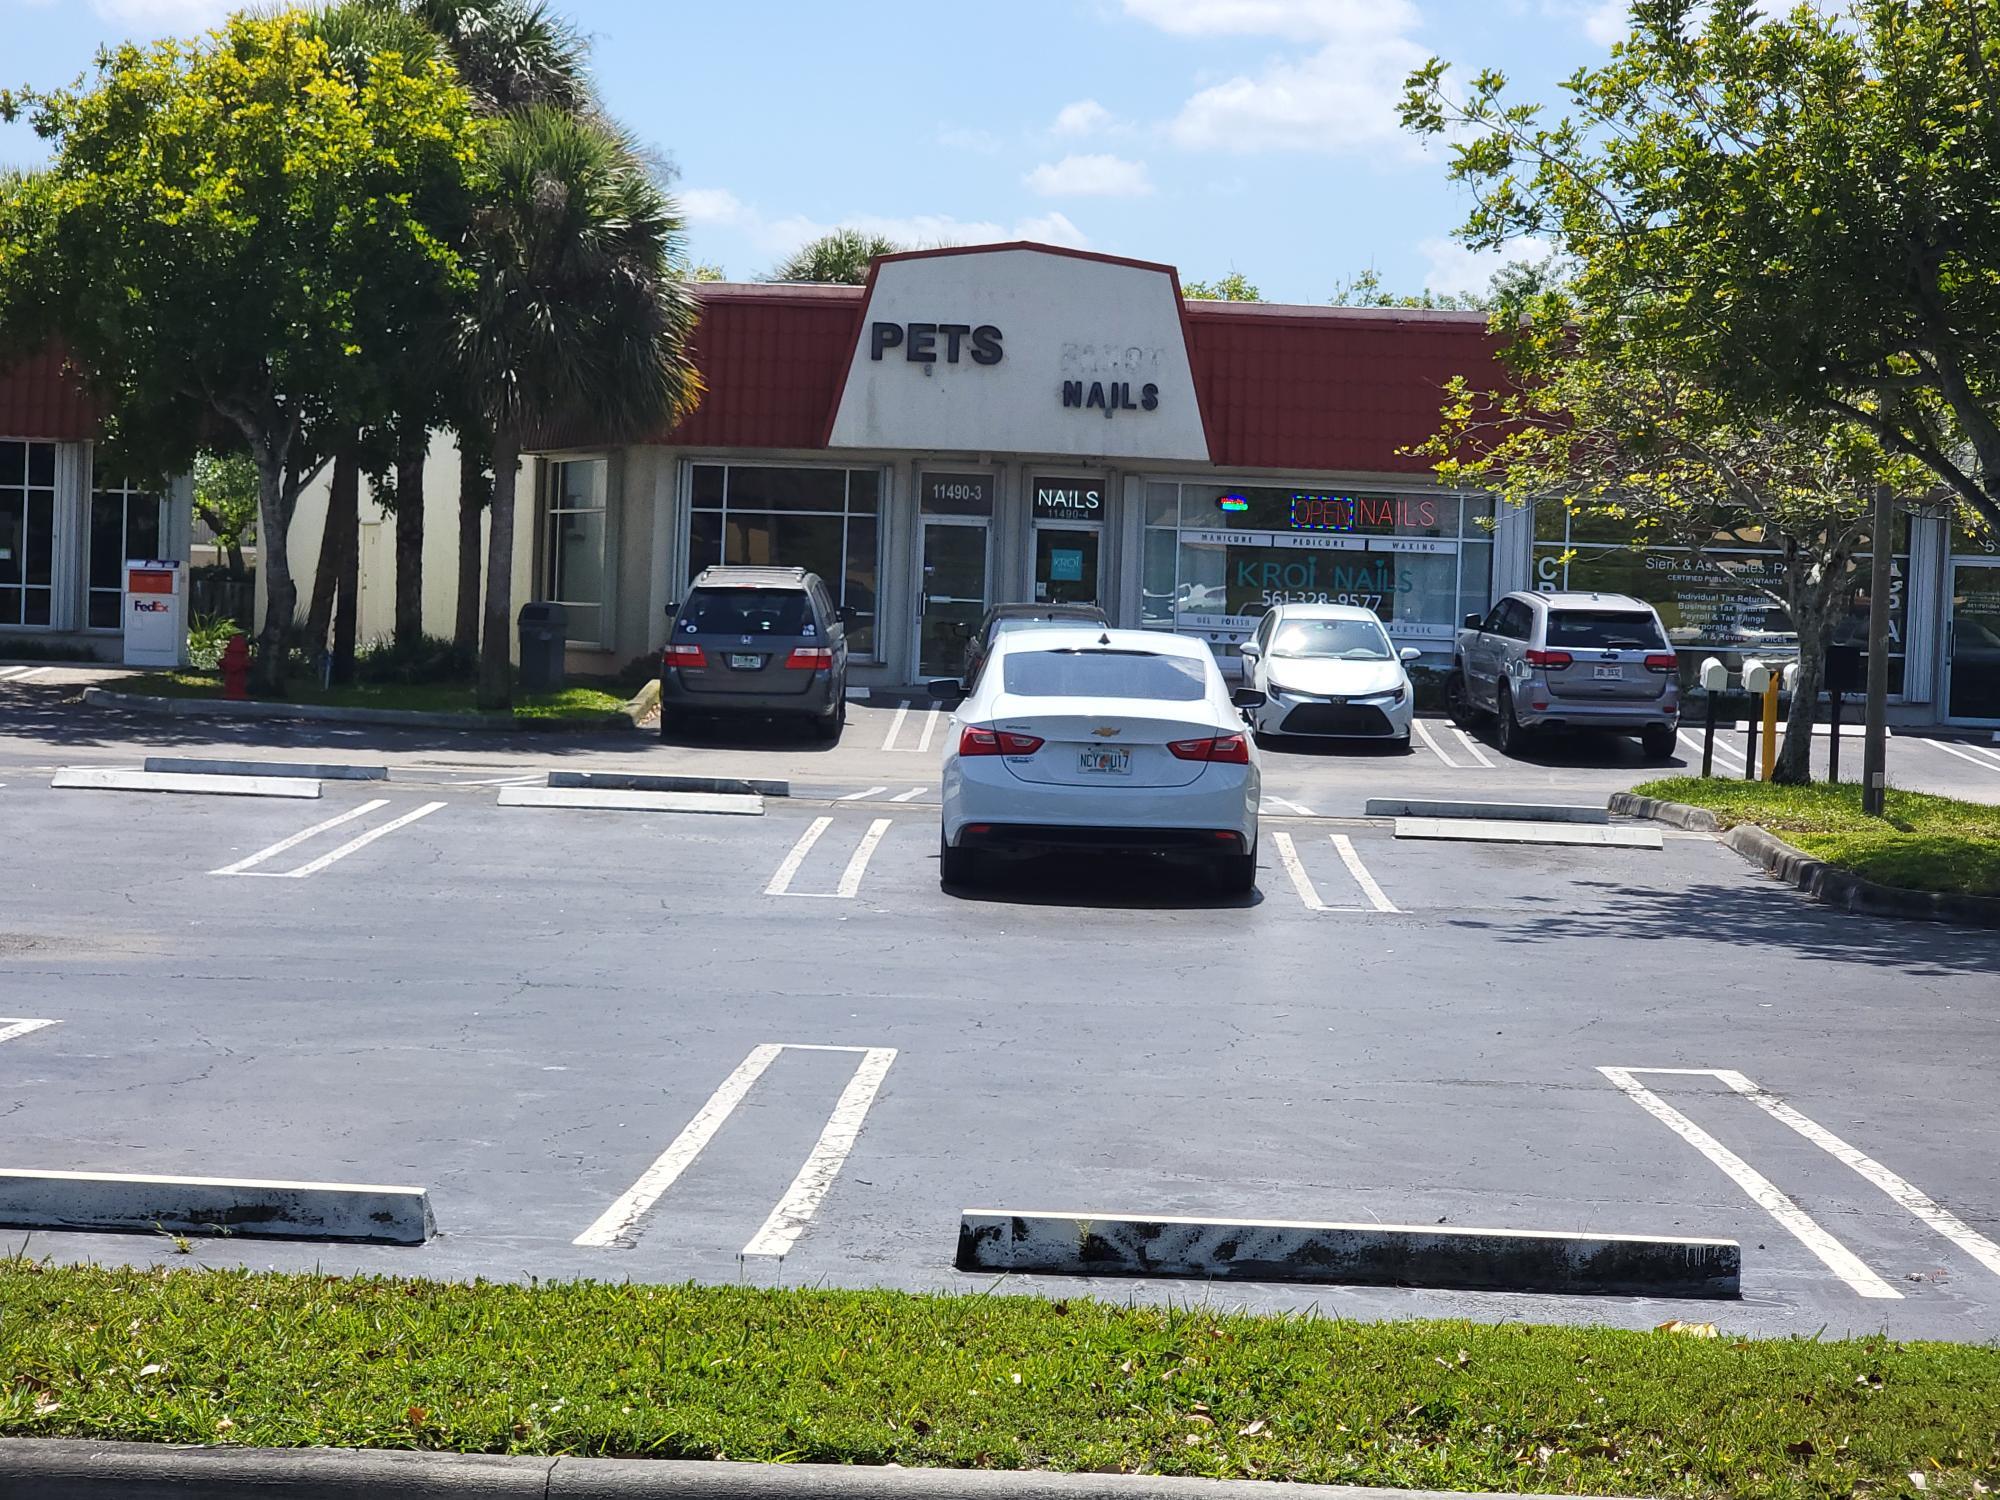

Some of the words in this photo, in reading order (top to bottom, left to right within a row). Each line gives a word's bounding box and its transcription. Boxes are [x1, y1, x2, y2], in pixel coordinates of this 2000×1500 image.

[871, 322, 1003, 365] PETS
[1062, 380, 1159, 411] NAILS
[933, 484, 982, 501] 11490-3
[1038, 488, 1099, 509] NAILS
[1048, 508, 1089, 520] 11490-4
[1295, 500, 1351, 526] OPEN
[1360, 499, 1436, 528] NAILS
[1201, 533, 1254, 544] MANICURE
[1292, 537, 1346, 548] PEDICURE
[1392, 542, 1436, 552] WAXING
[1645, 557, 1678, 571] Sierk
[1682, 559, 1692, 571] &
[1667, 574, 1703, 583] CERTIFIED
[1704, 575, 1730, 583] PUBLIC
[1261, 589, 1383, 612] 561-328-9577
[1677, 592, 1719, 602] Individual
[1721, 593, 1735, 602] Tax
[1737, 594, 1771, 604] Returns
[134, 600, 169, 613] FedEx
[1677, 602, 1717, 611] Business
[1719, 603, 1733, 612] Tax
[1680, 612, 1710, 622] Payroll
[1711, 613, 1720, 621] &
[1721, 614, 1735, 622] Tax
[1080, 753, 1098, 768] NCY
